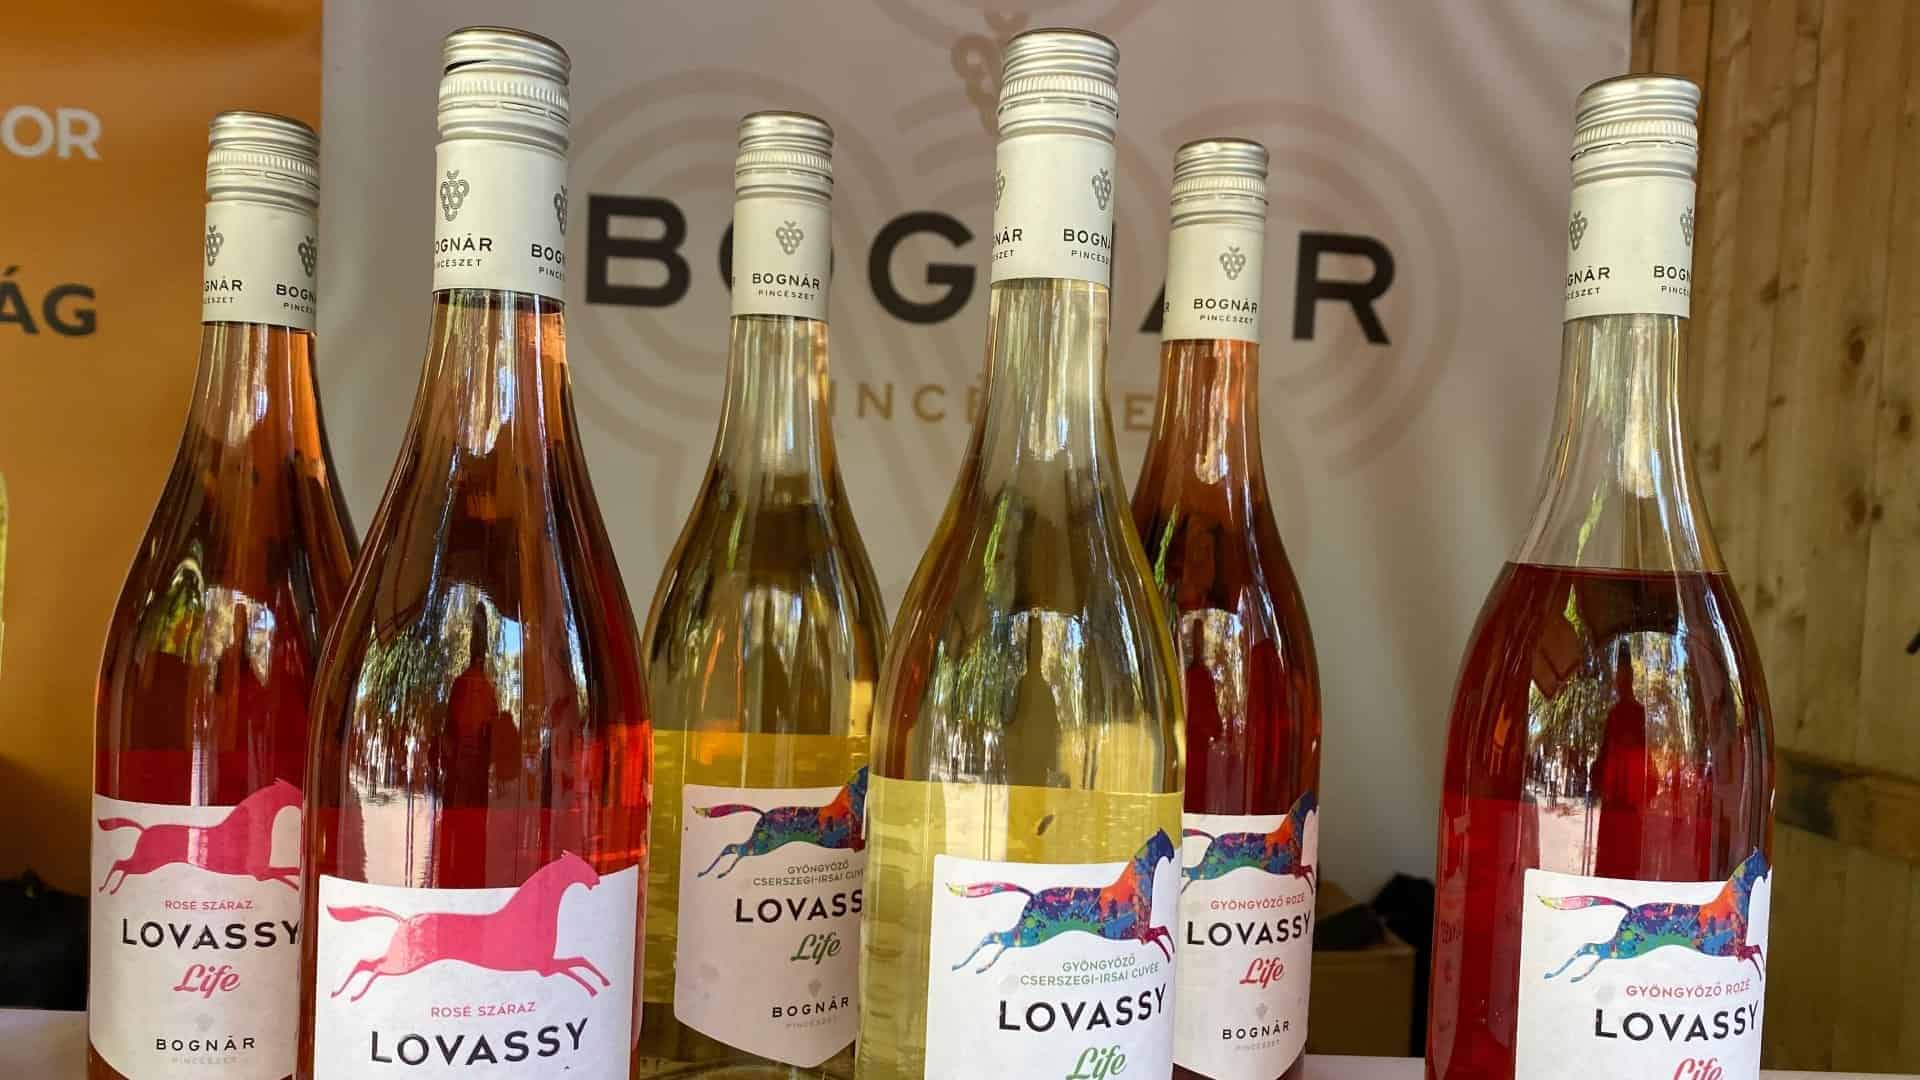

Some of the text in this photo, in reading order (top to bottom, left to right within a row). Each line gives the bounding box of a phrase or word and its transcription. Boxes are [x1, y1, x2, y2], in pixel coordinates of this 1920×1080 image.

[752, 272, 820, 290] BOGNÁR
[1193, 298, 1258, 314] BOGNÁR
[122, 918, 301, 949] LOVASSY
[1187, 909, 1312, 946] LOVASSY
[791, 931, 841, 965] Life
[173, 963, 241, 999] Life
[1239, 957, 1284, 989] Life
[431, 1002, 536, 1017] ROSÉ SZÁRAZ
[772, 995, 849, 1018] BOGNÁR
[999, 983, 1167, 1032] LOVASSY
[1594, 1000, 1759, 1042] LOVASSY
[156, 1035, 255, 1051] BOGNÁR
[371, 1017, 588, 1066] LOVASSY
[1222, 1019, 1290, 1040] BOGNÁR
[1066, 1044, 1127, 1080] Life
